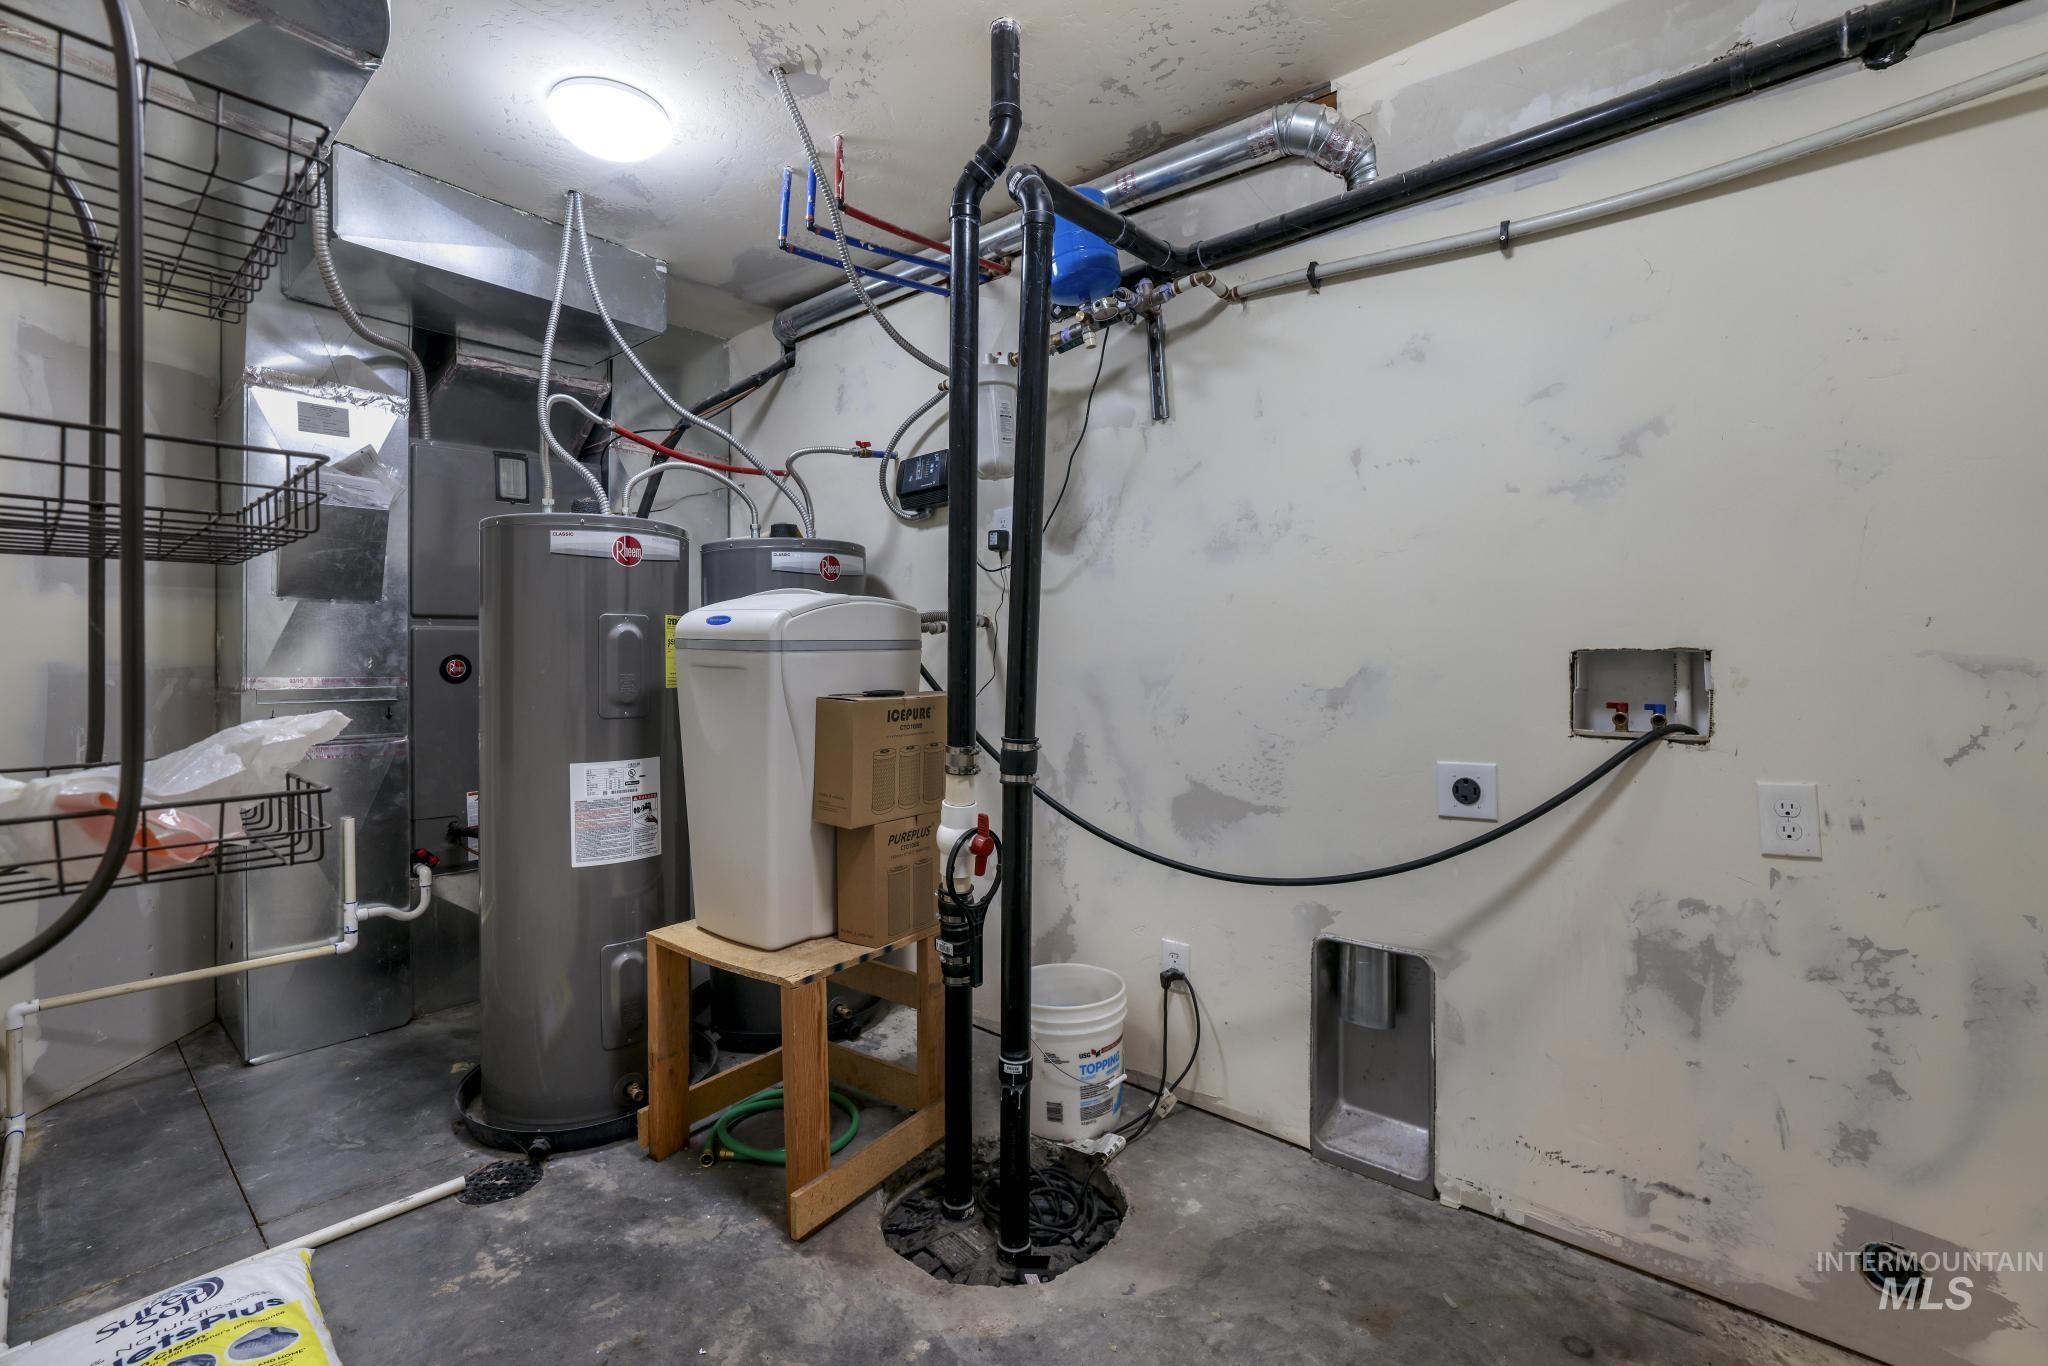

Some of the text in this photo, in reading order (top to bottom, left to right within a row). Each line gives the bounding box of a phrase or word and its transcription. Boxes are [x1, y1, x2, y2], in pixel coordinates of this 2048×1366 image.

[616, 536, 642, 561] Rheem
[821, 555, 840, 577] Rheem
[887, 706, 932, 722] ICEPURE
[888, 825, 931, 847] PUREPLUS
[1079, 1050, 1120, 1075] TOPPING
[95, 1293, 184, 1344] Sure
[136, 1287, 209, 1334] Soft
